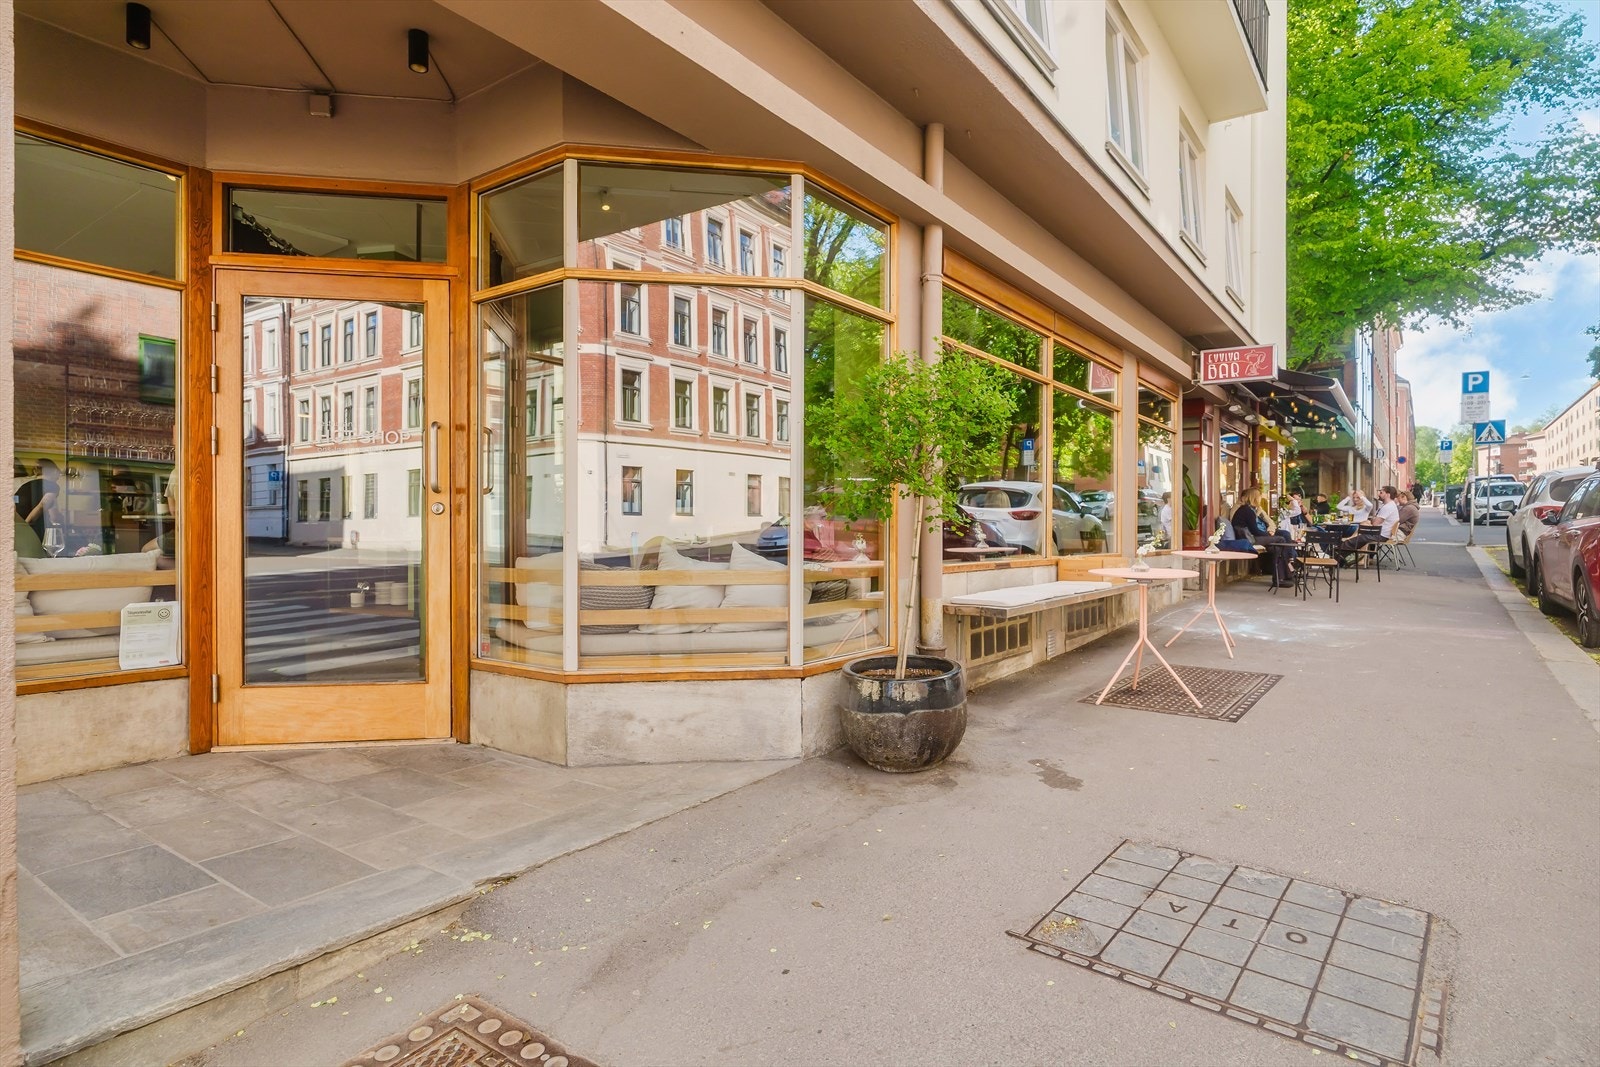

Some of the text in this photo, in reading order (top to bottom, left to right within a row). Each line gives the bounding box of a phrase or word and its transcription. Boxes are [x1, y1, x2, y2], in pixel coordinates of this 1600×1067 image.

[1208, 352, 1240, 363] EVVIVA
[1208, 362, 1240, 380] BAR
[1468, 374, 1483, 391] P
[360, 430, 411, 444] SHOP
[1443, 442, 1450, 450] P
